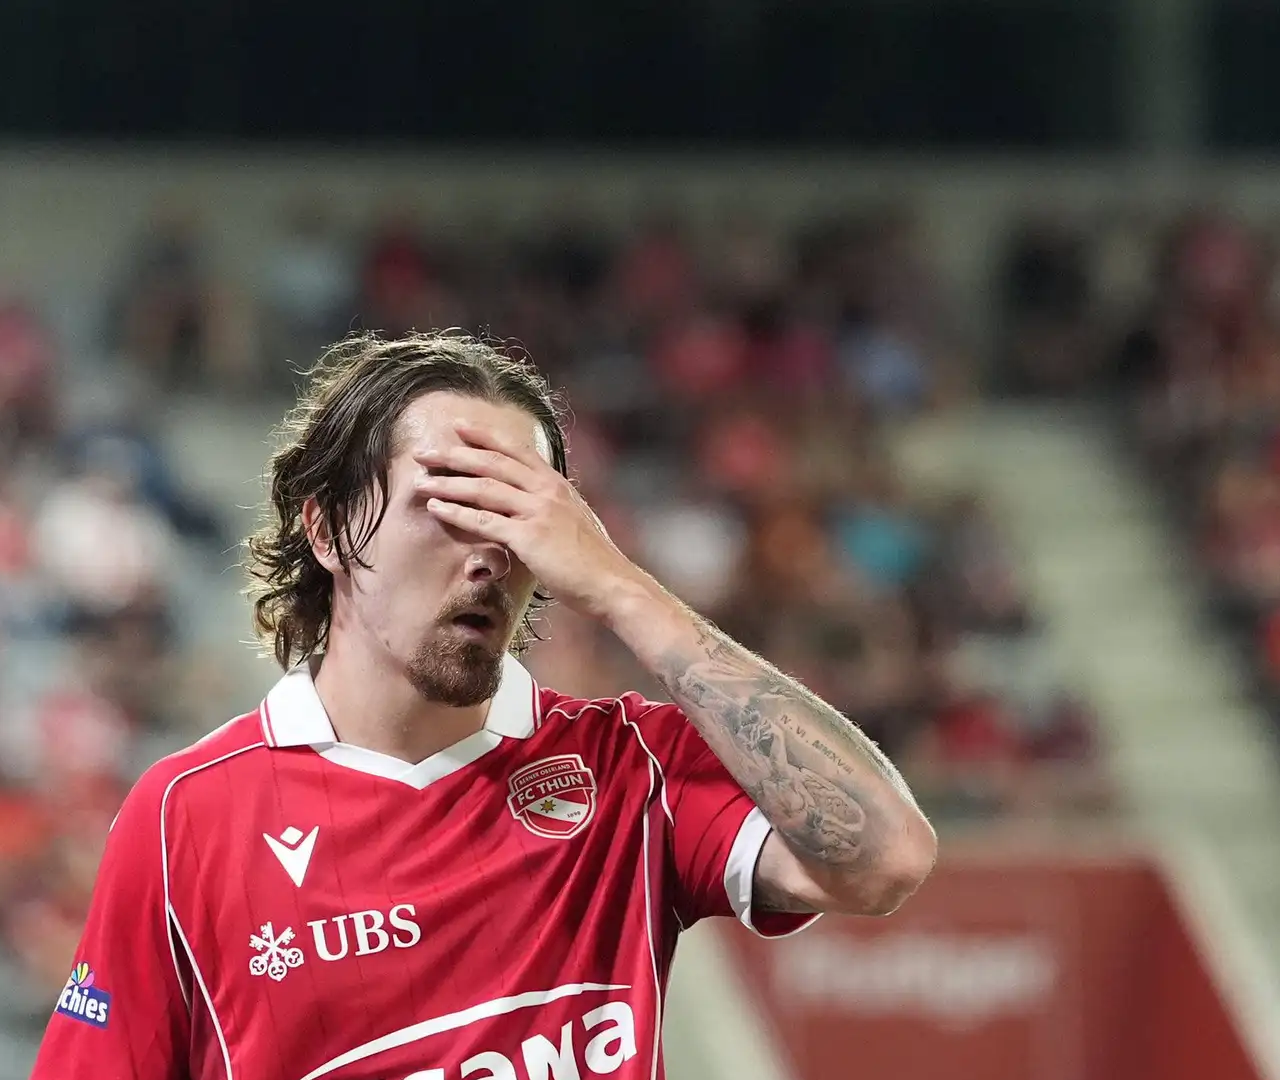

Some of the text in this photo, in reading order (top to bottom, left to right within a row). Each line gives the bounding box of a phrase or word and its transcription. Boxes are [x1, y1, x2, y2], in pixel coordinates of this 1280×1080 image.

[516, 773, 584, 806] FC THUN
[307, 903, 422, 962] UBS
[60, 985, 108, 1023] chies
